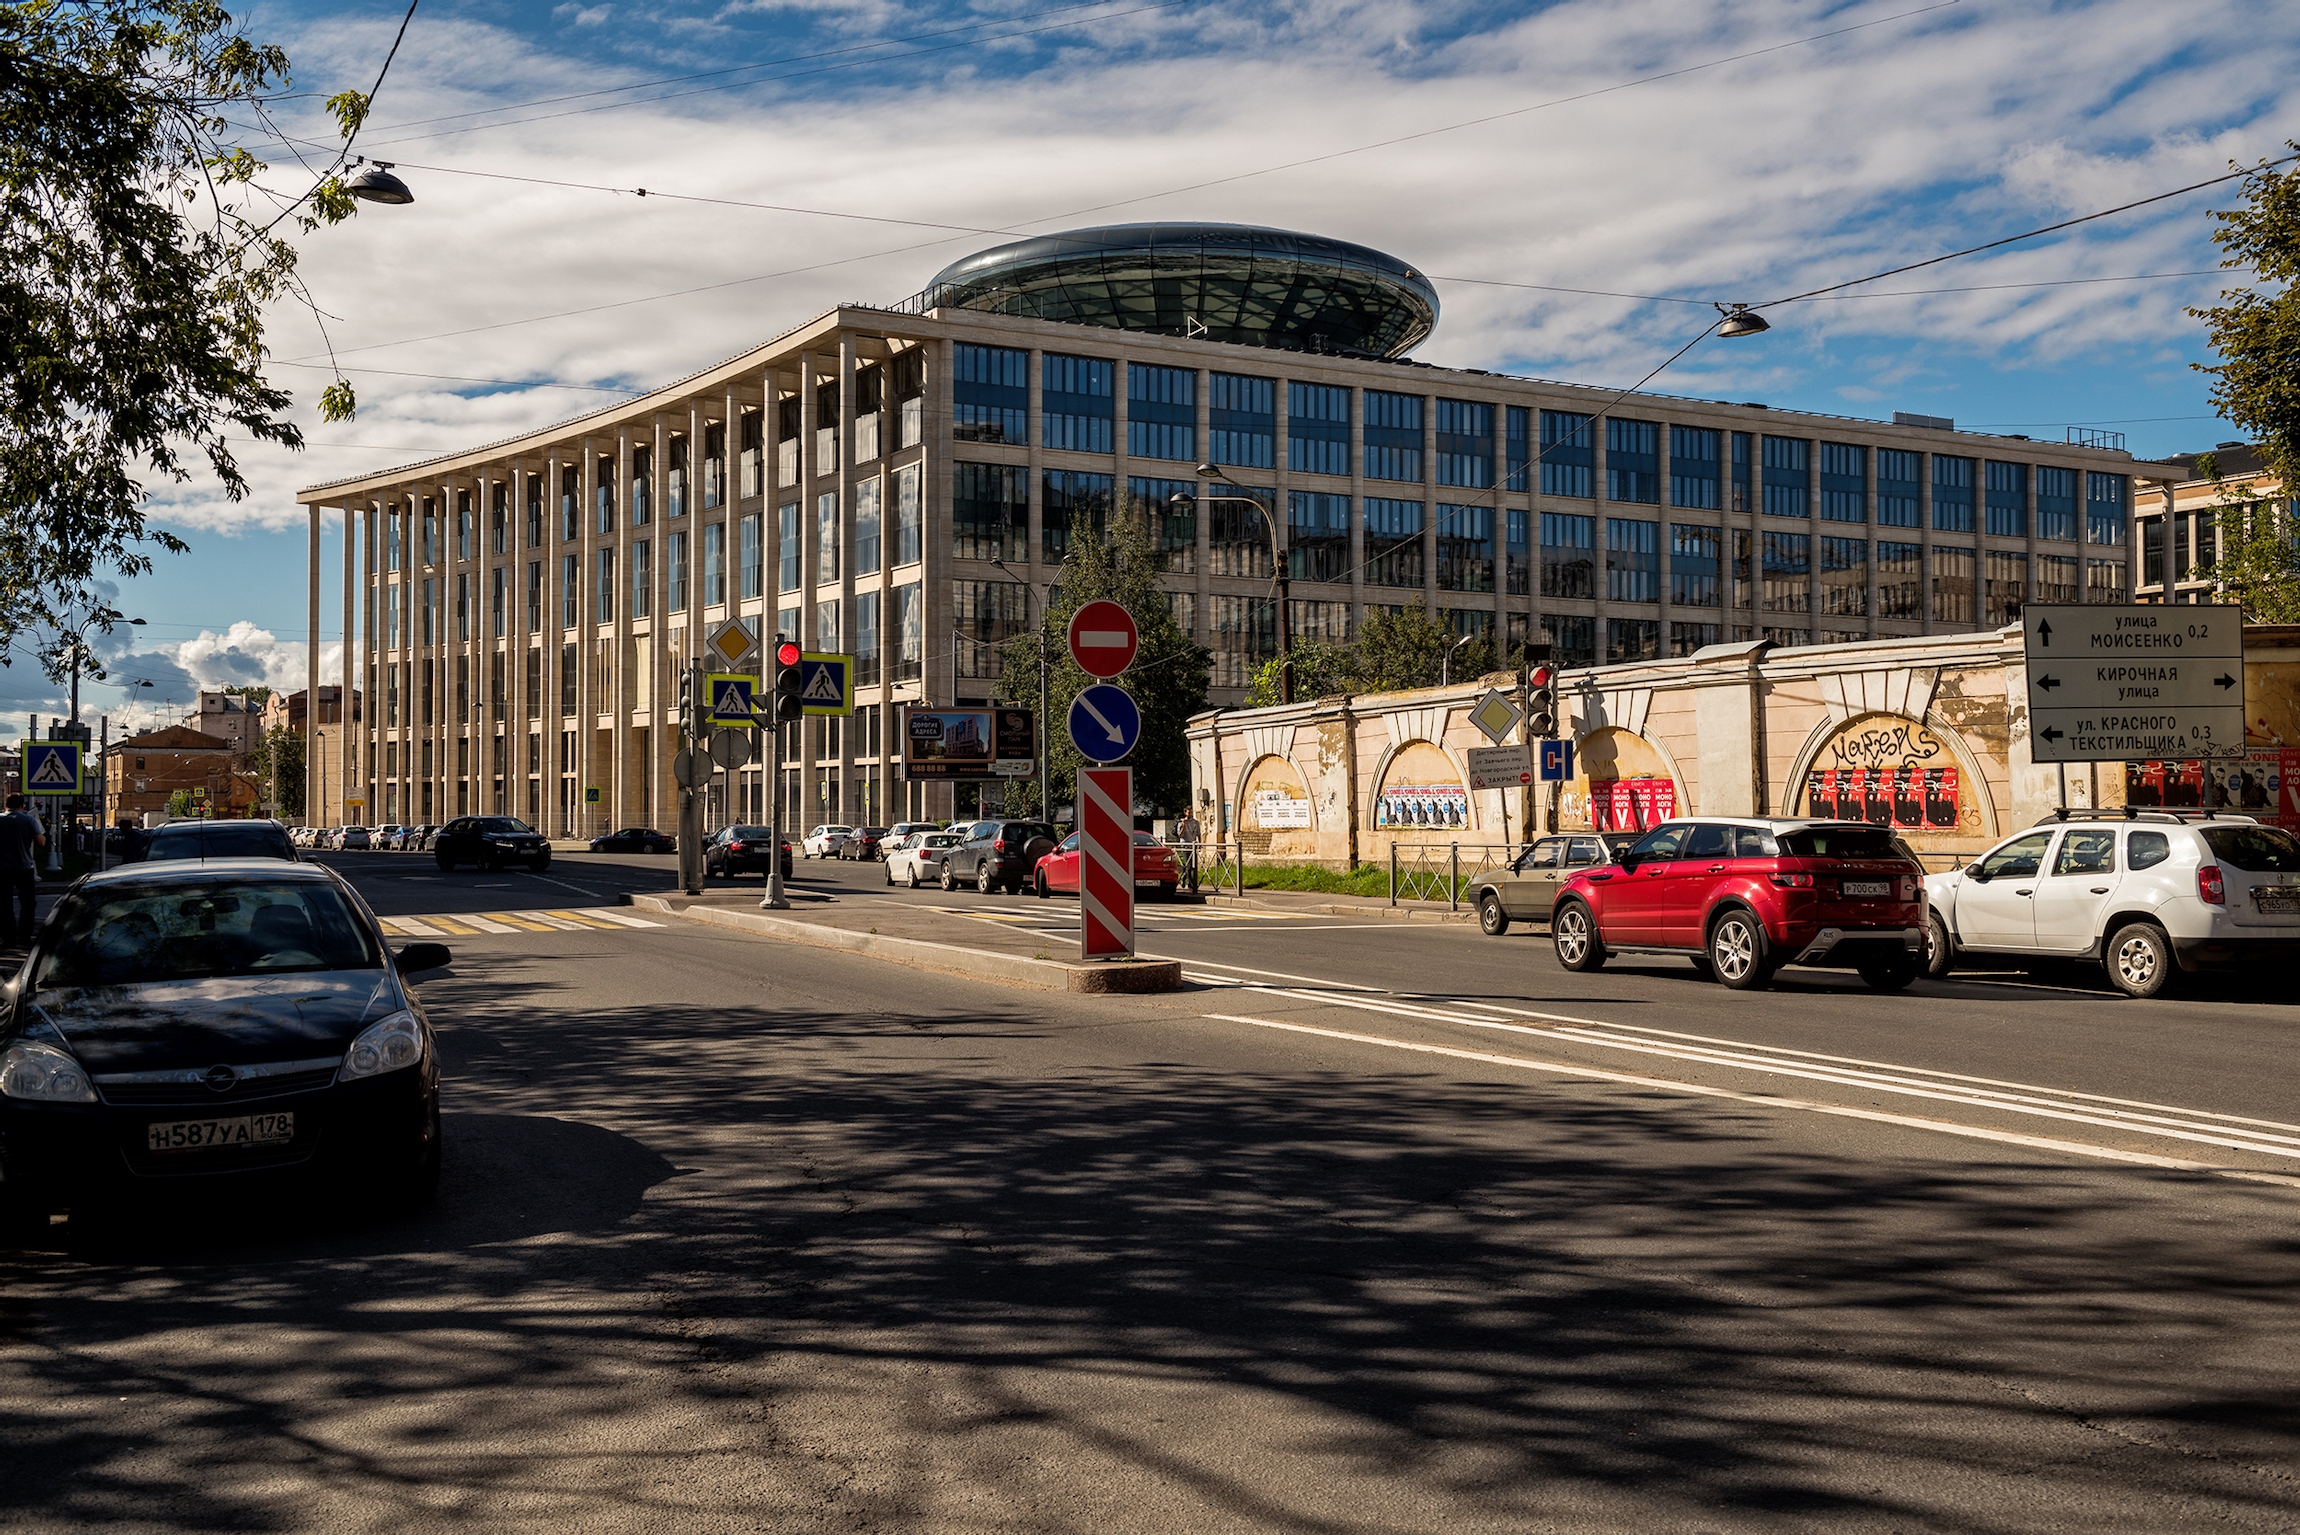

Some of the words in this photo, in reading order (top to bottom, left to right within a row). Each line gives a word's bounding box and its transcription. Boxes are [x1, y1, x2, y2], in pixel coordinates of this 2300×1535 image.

[2115, 616, 2157, 630] улица
[2188, 624, 2208, 640] 0,2
[2091, 633, 2183, 648] МОИСЕЕНКО
[2097, 667, 2178, 682] КИРОЧНАЯ
[2118, 685, 2160, 700] улица
[2077, 719, 2096, 734] ул.
[2101, 716, 2176, 731] КРАСНОГО
[2191, 726, 2211, 741] 0,3
[2069, 736, 2187, 752] ТЕКСТИЛЬЩИКА
[1488, 775, 1519, 784] ЗАКРЫТ!
[156, 1122, 250, 1148] Н587УА
[255, 1115, 288, 1133] 178
[261, 1132, 278, 1140] RUS
